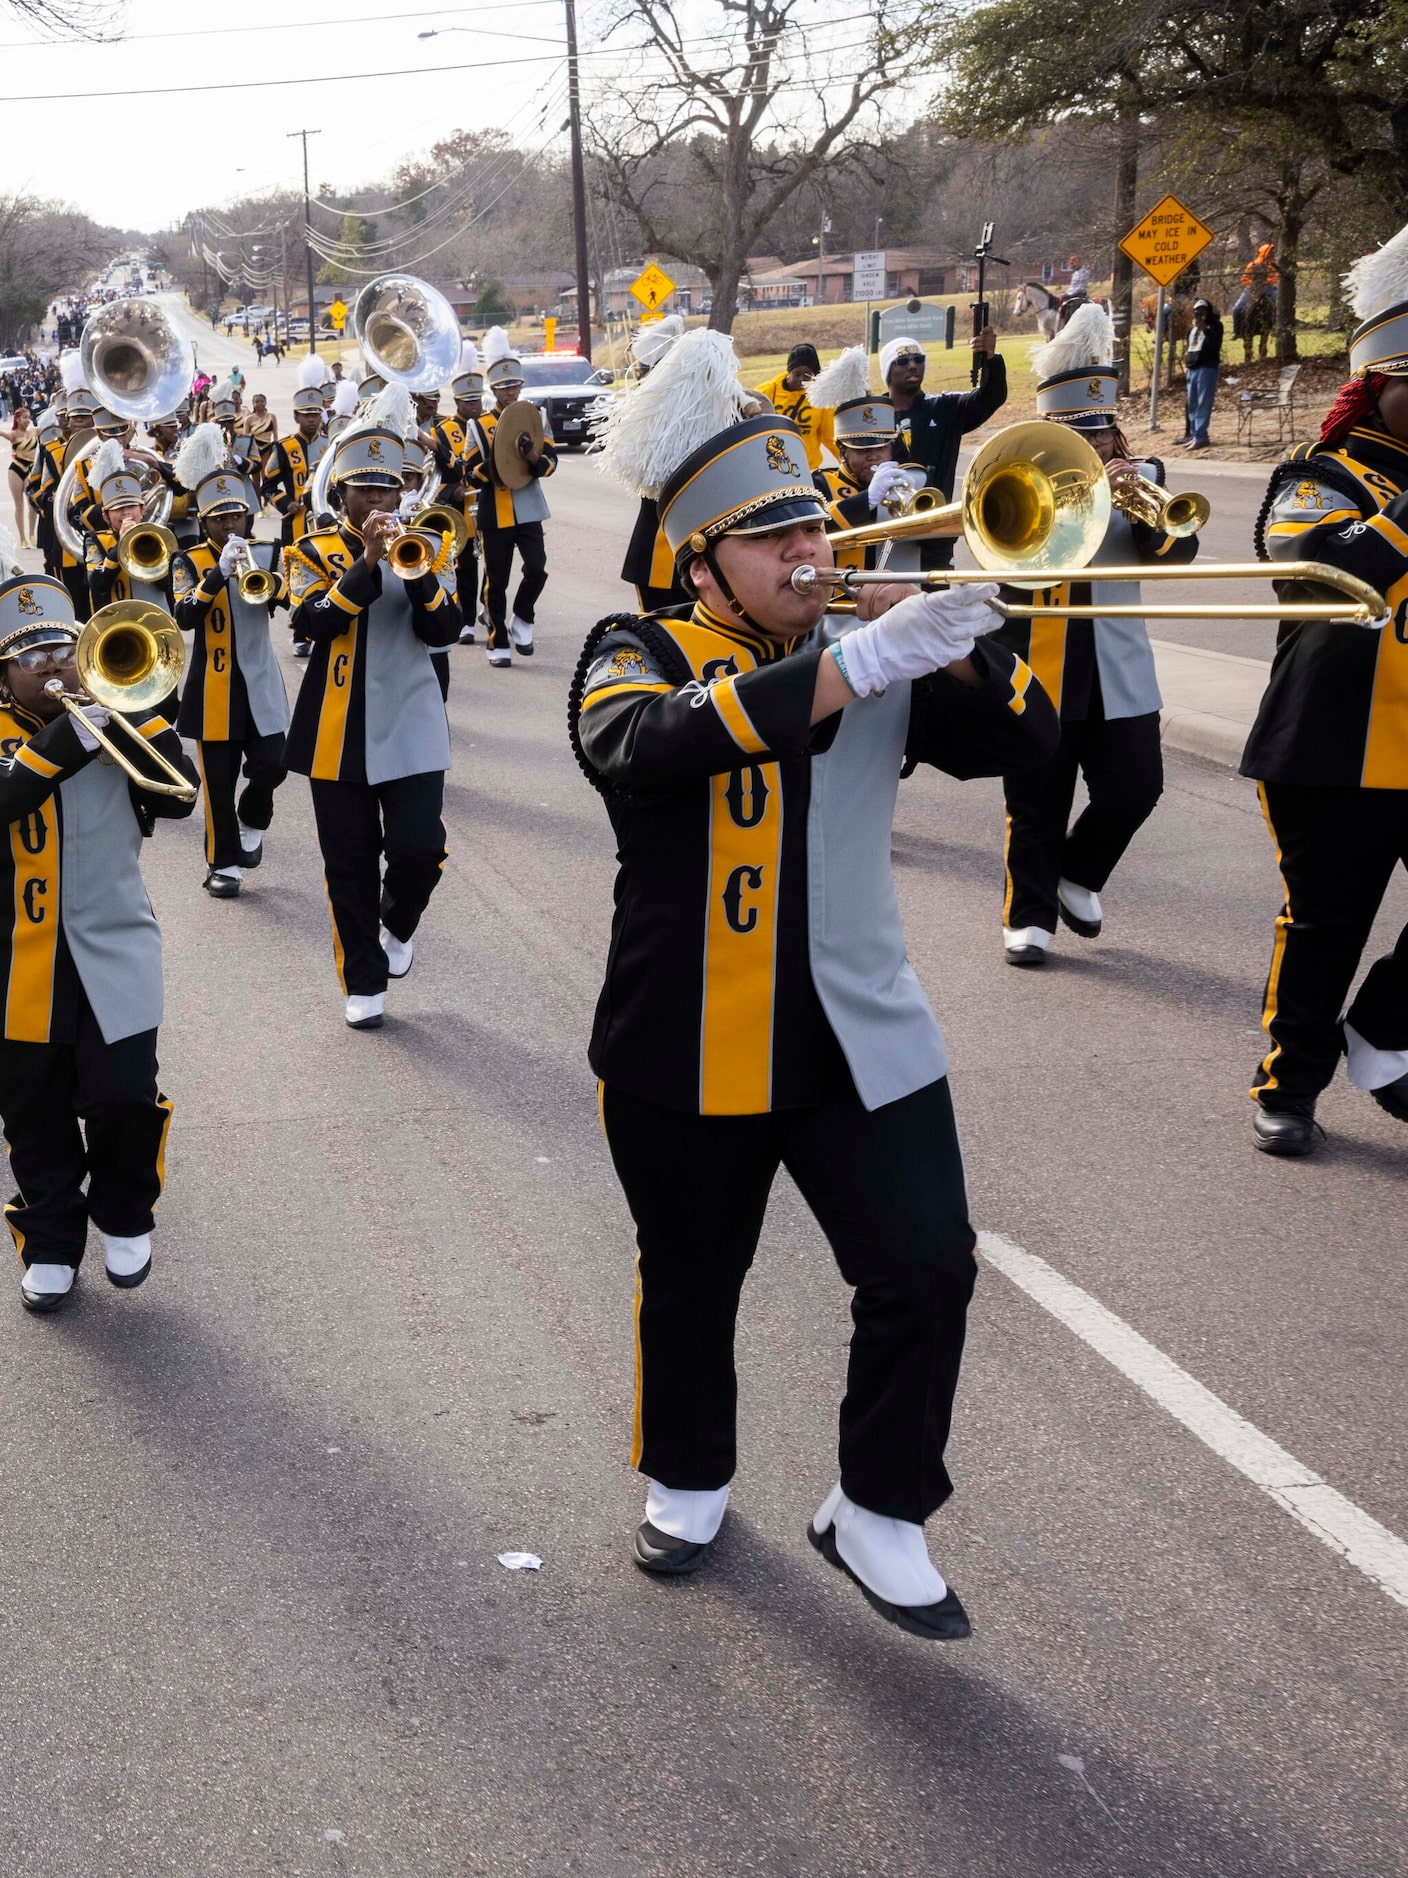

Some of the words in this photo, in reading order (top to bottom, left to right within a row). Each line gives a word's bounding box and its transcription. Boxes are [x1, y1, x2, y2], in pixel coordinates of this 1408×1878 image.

[1151, 213, 1185, 225] BRIDGE
[1138, 229, 1158, 239] MAY
[1165, 227, 1180, 238] ICE
[1187, 226, 1197, 236] IN
[1154, 241, 1179, 252] COLD
[1145, 253, 1187, 265] WEATHER
